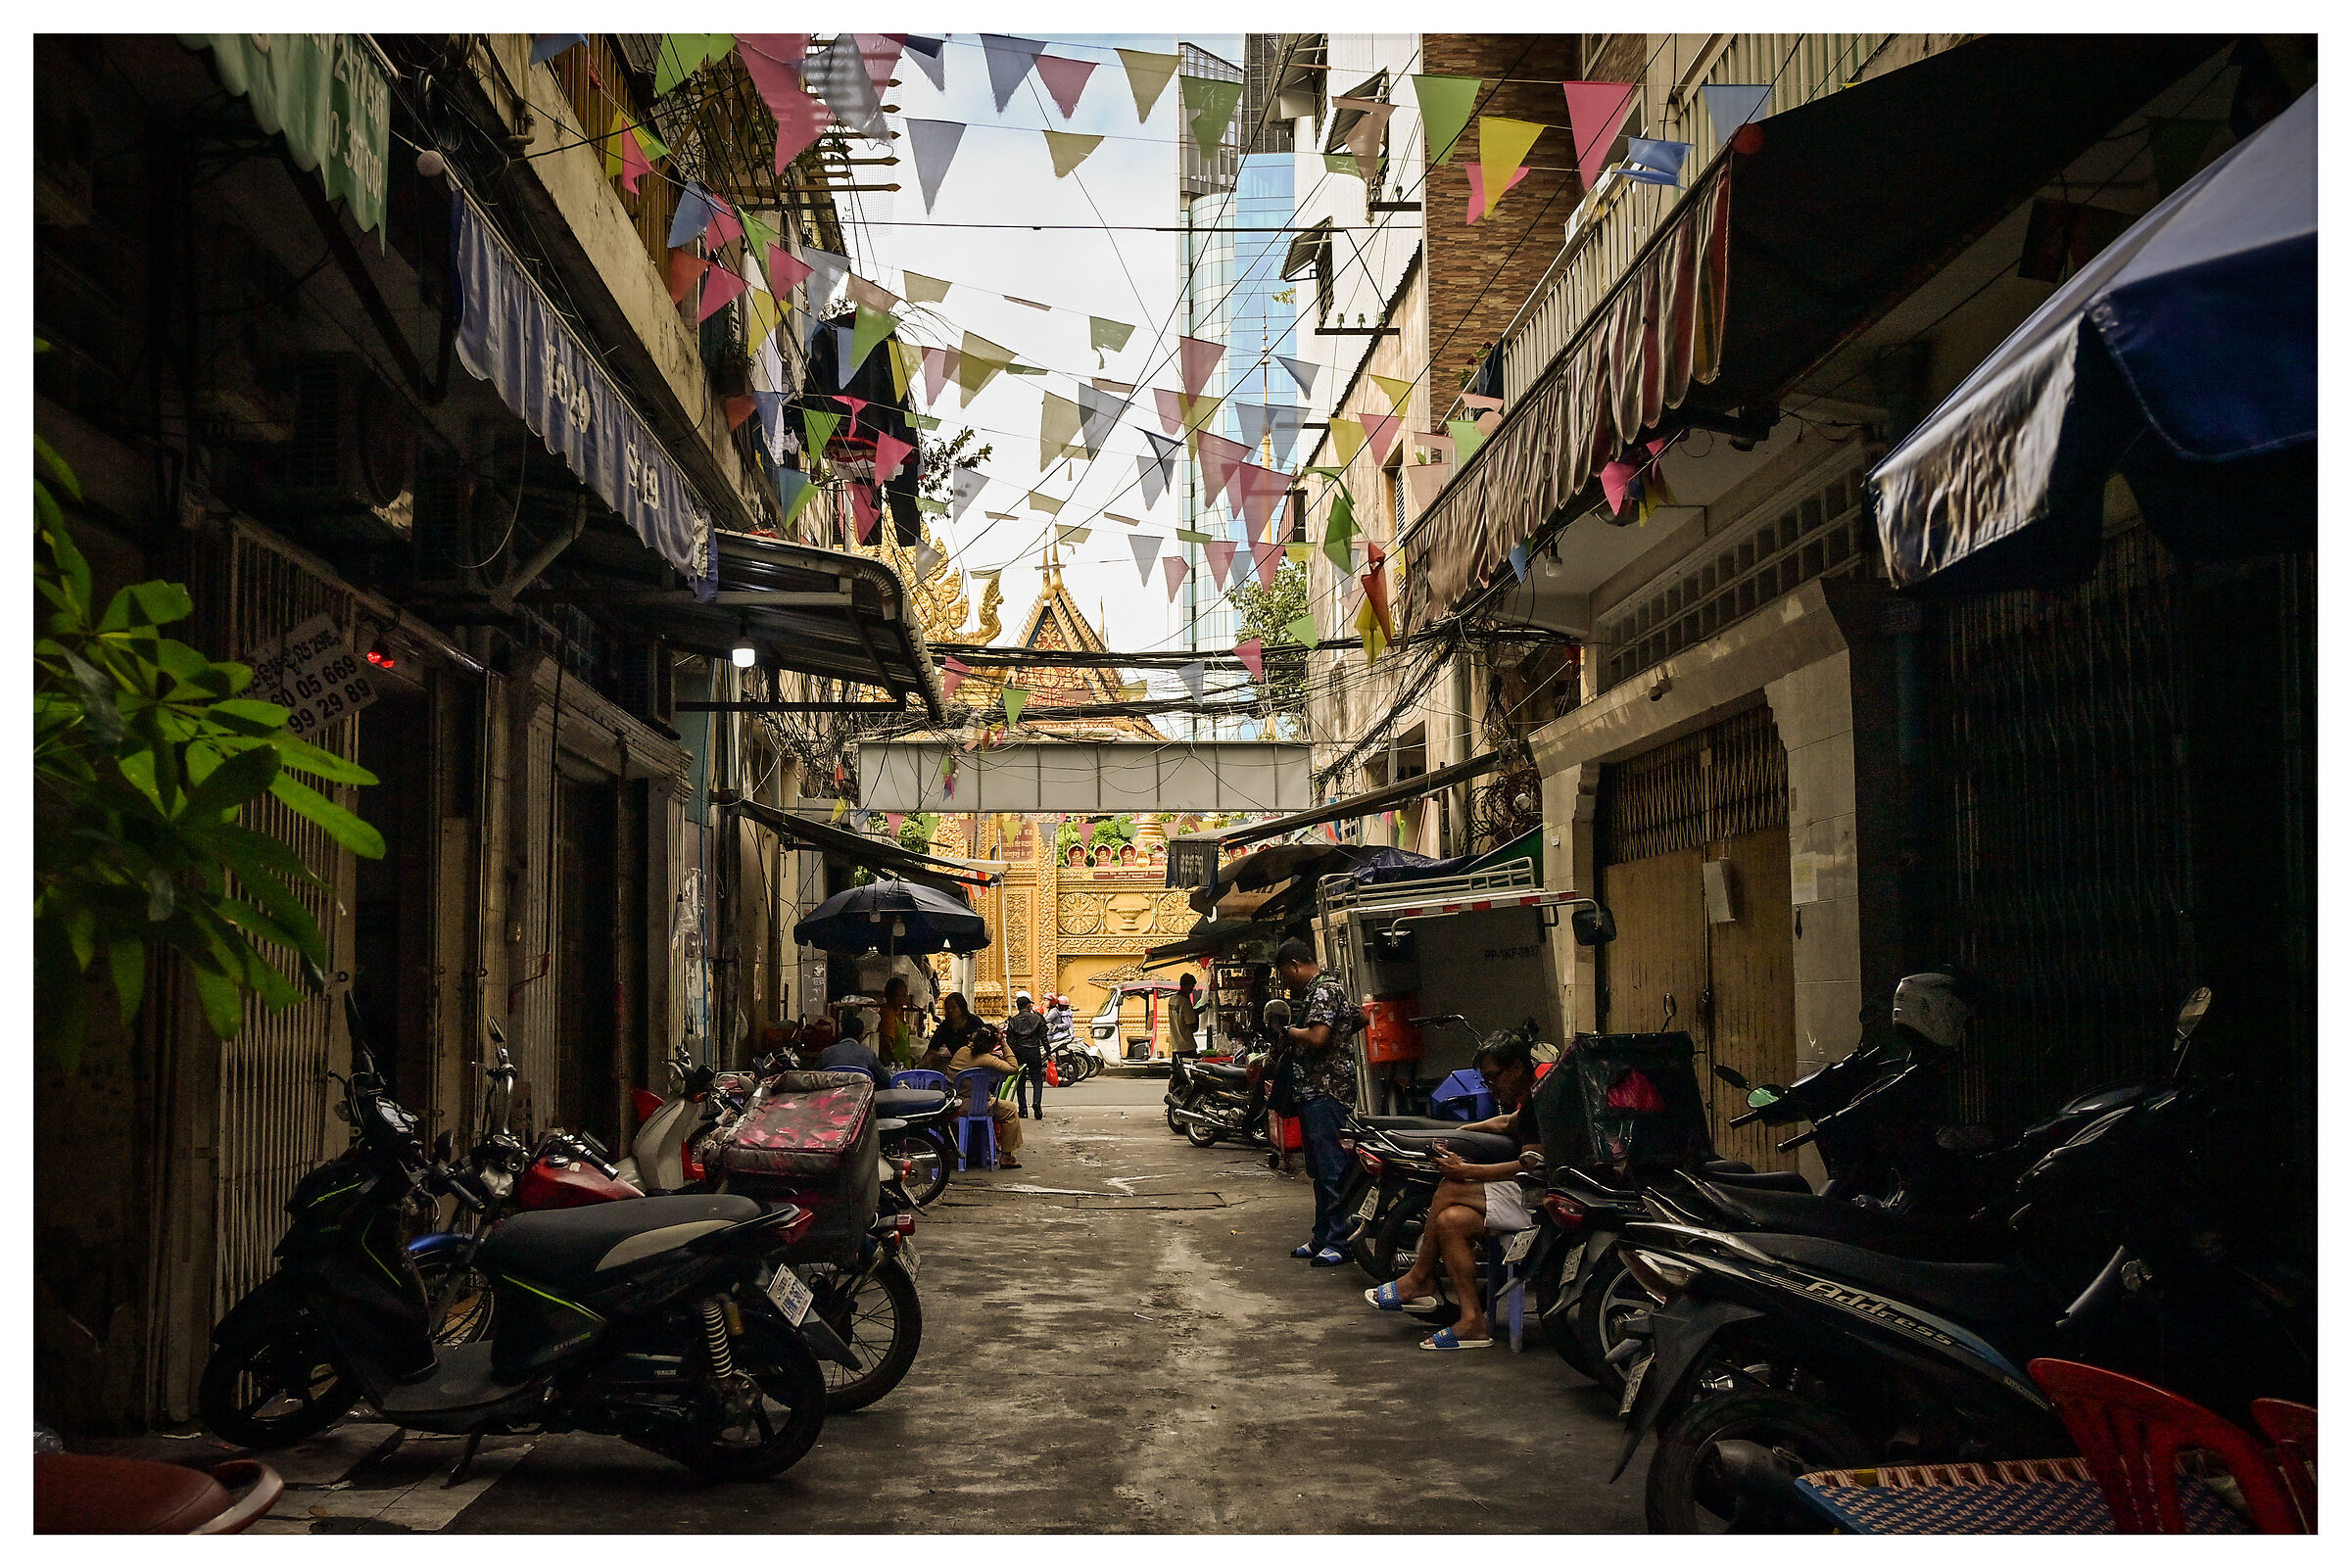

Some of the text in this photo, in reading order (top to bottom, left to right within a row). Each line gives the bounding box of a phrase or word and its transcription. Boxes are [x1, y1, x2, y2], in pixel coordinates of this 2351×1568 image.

[296, 674, 322, 699] 05
[322, 655, 357, 685] 669
[316, 692, 344, 719] 29
[1804, 1281, 1955, 1347] Address
